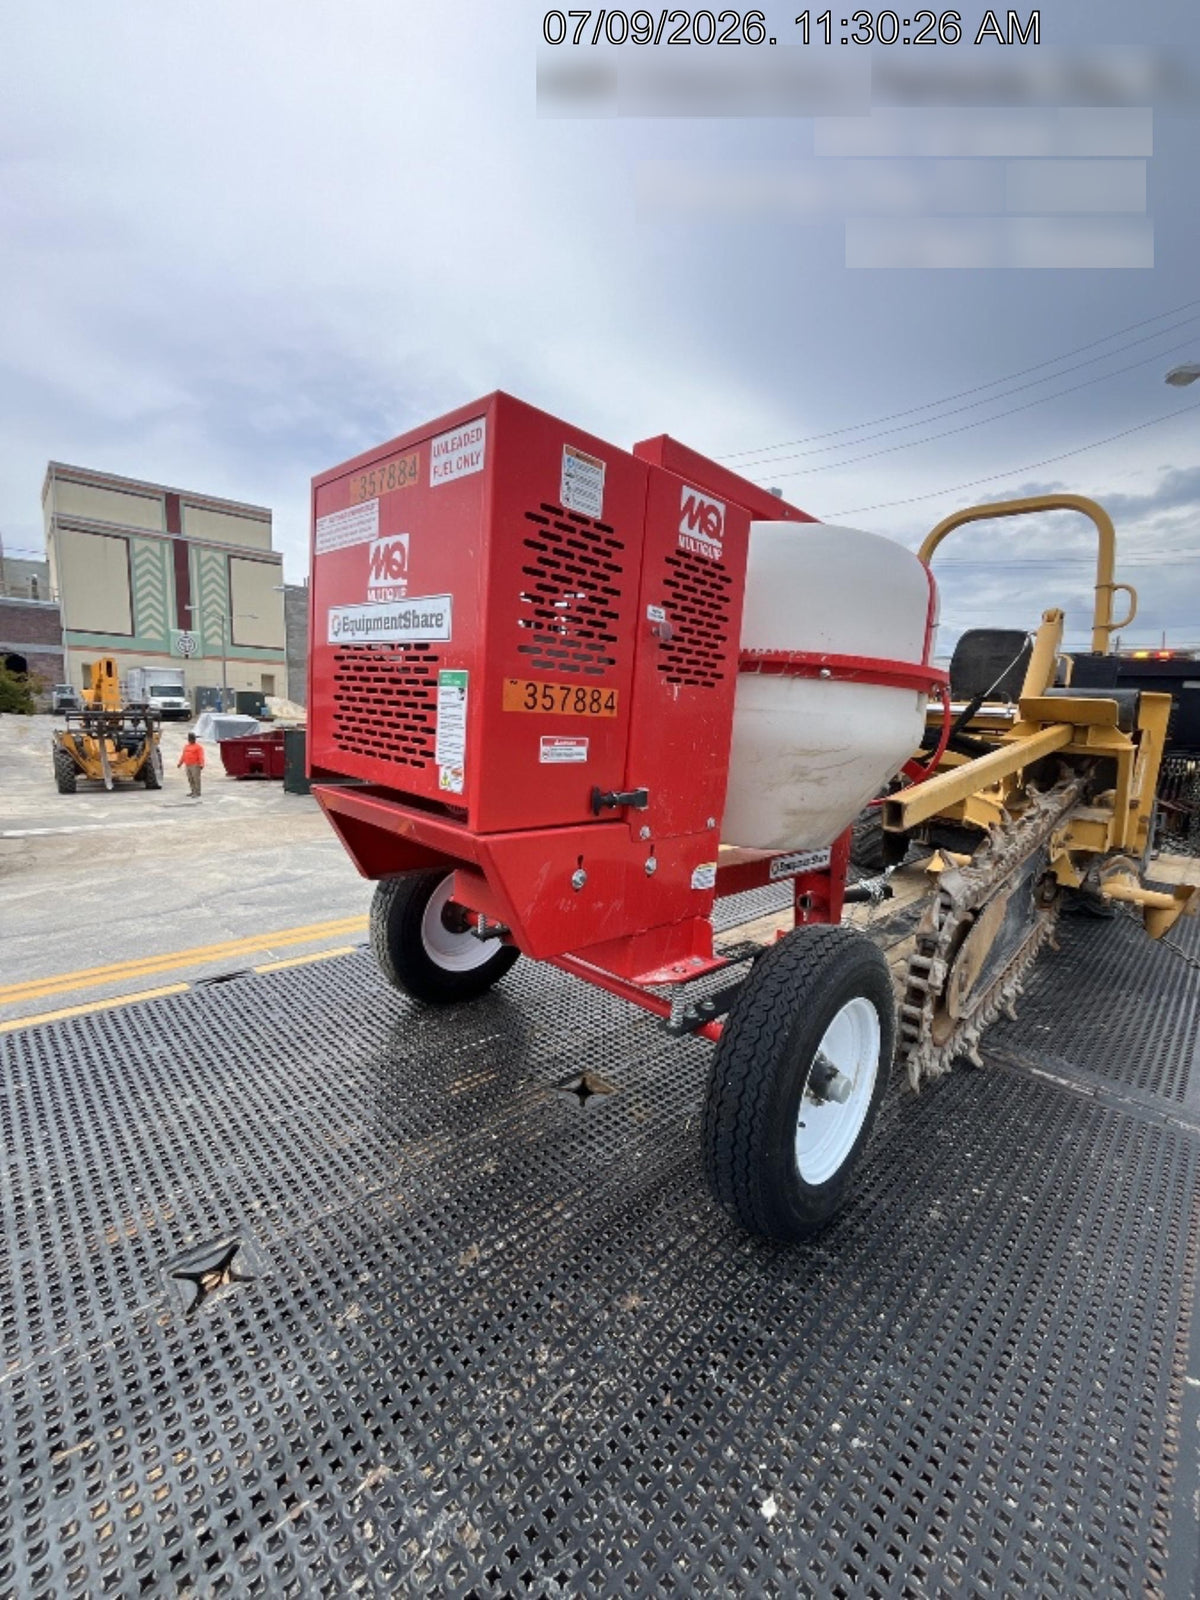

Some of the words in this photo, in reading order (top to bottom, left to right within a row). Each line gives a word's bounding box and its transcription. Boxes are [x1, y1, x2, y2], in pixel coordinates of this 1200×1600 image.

[432, 427, 482, 458] UNLEADED
[456, 451, 481, 470] ONLY
[358, 455, 418, 499] 357884
[679, 489, 725, 543] MQ
[369, 537, 409, 584] MQ
[342, 609, 444, 636] EquipmentShare
[523, 682, 616, 714] 357884
